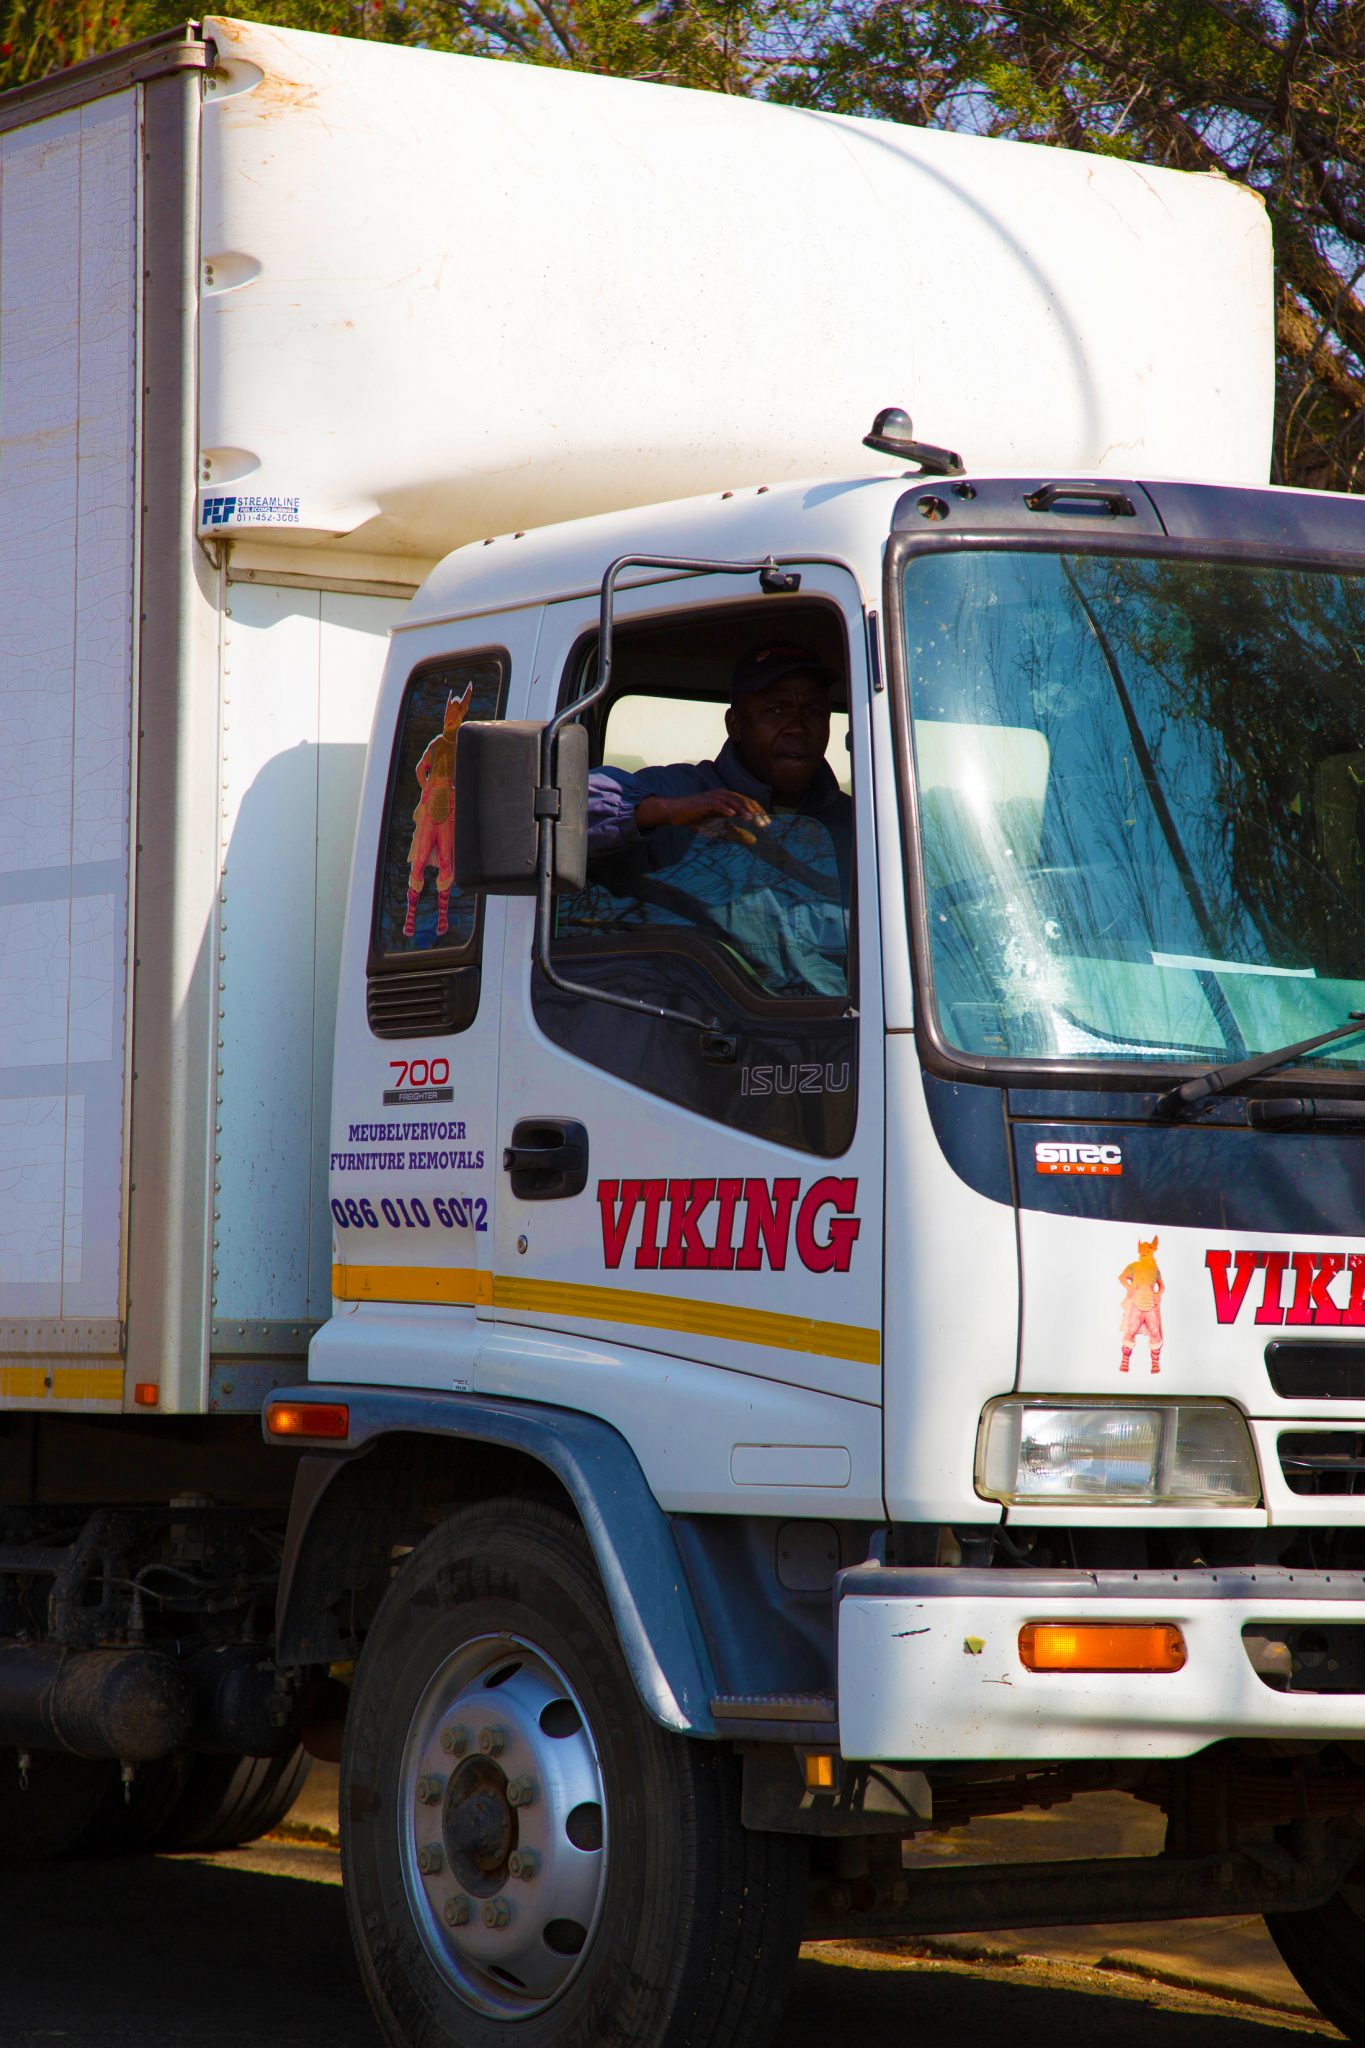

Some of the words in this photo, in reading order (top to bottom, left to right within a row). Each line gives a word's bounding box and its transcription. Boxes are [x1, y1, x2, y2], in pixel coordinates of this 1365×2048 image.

[237, 497, 300, 507] STREAMLINE
[389, 1058, 450, 1088] 700
[740, 1062, 850, 1096] ISUZU
[398, 1091, 438, 1102] FREIGHTER
[348, 1121, 466, 1142] MEUBELVERVOER
[330, 1151, 405, 1171] FURNITURE
[408, 1150, 485, 1170] REMOVALS
[1049, 1164, 1110, 1173] POWER
[331, 1197, 379, 1229] 086
[380, 1197, 431, 1229] 010
[432, 1197, 488, 1232] 6072
[596, 1176, 862, 1274] VIKING
